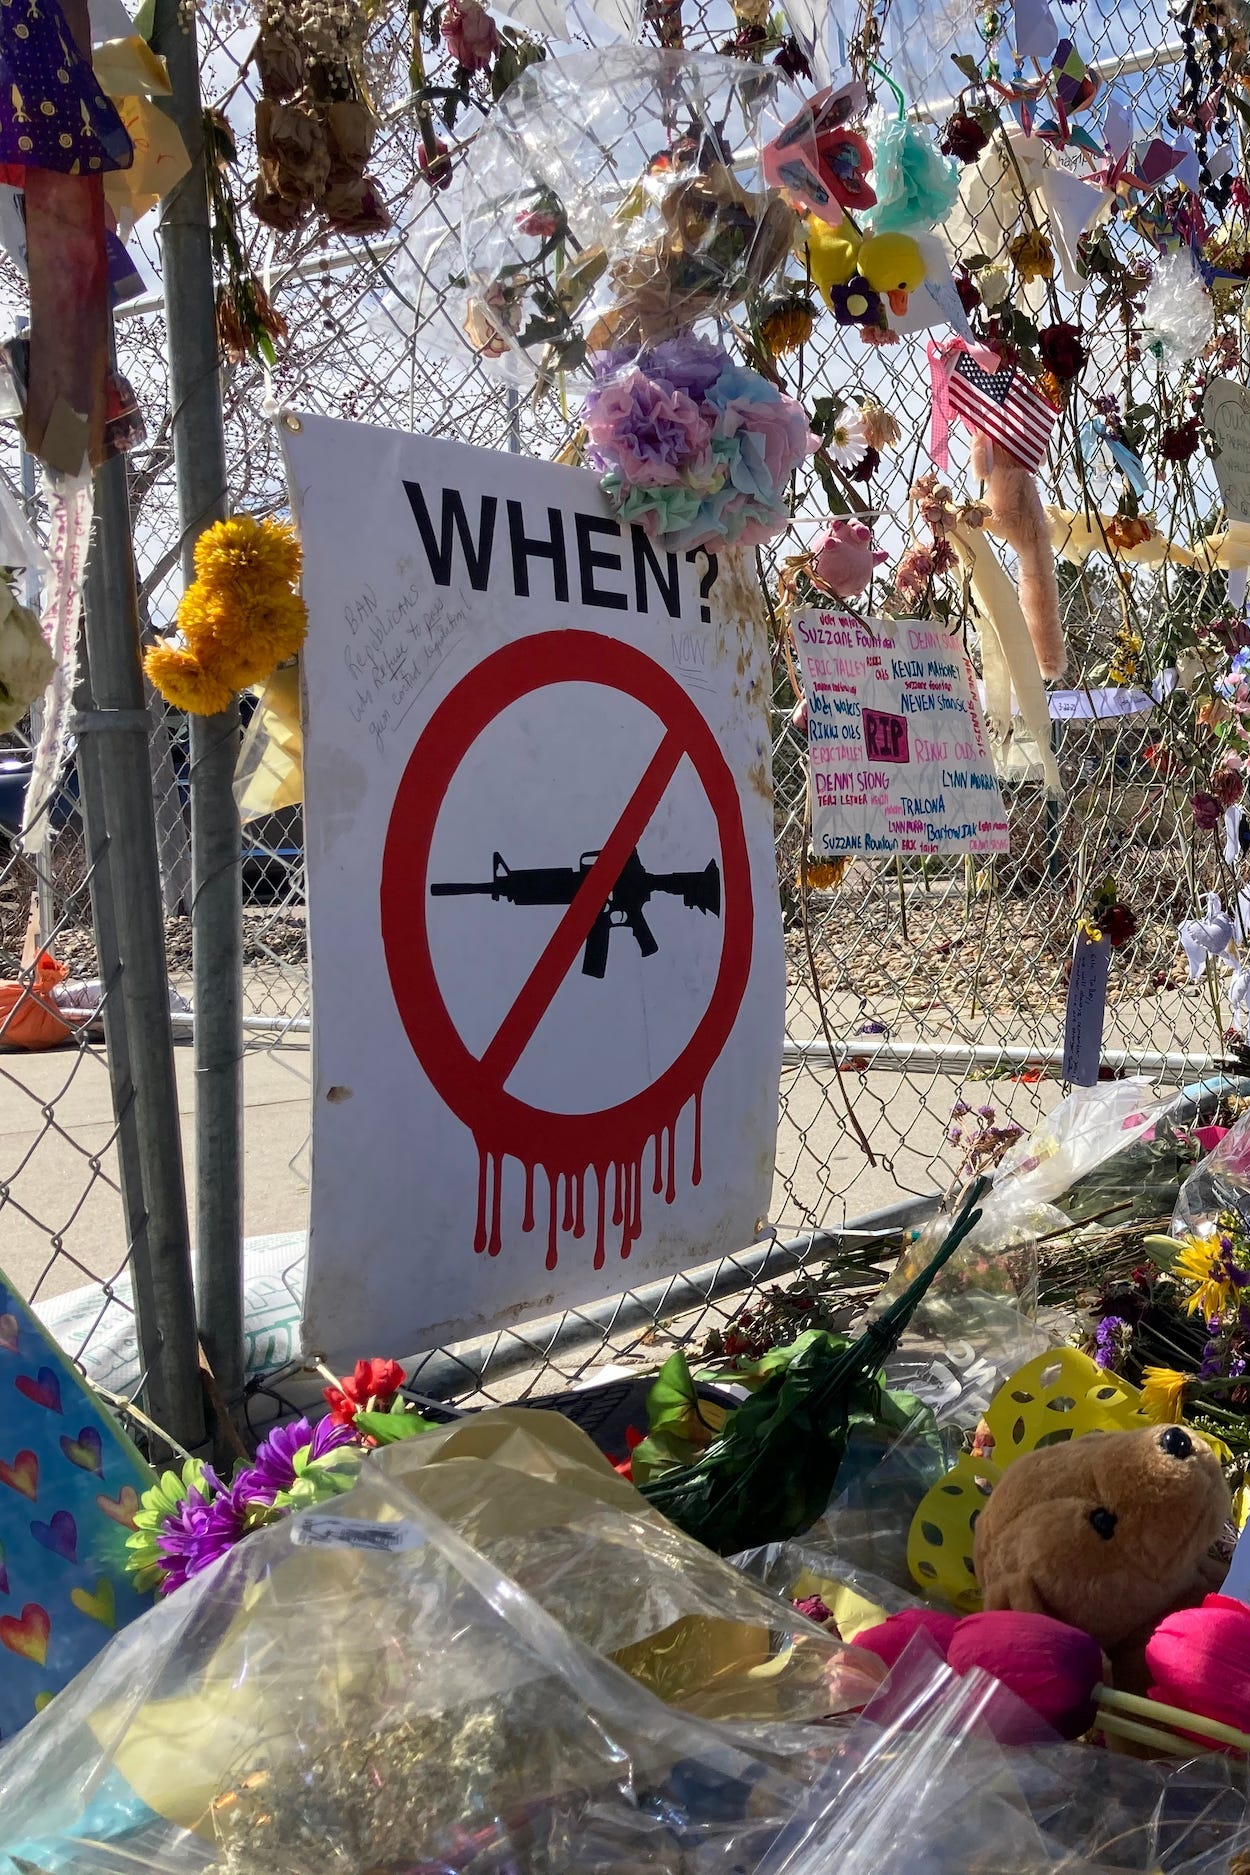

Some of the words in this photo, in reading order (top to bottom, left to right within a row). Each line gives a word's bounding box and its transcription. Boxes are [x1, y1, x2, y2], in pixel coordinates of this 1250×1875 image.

[402, 480, 718, 623] WHEN?
[345, 583, 378, 636] BAN
[406, 618, 422, 641] to
[671, 633, 708, 666] NOW
[807, 656, 832, 679] ERIC
[891, 659, 924, 680] KEVIN
[901, 693, 935, 714] NEVEN
[368, 709, 392, 754] gun
[866, 713, 904, 758] RIP
[914, 739, 948, 764] RIKKI
[815, 772, 854, 795] DENNY
[857, 770, 890, 792] STONG
[941, 768, 968, 790] LYNN
[900, 793, 946, 817] TRALONA
